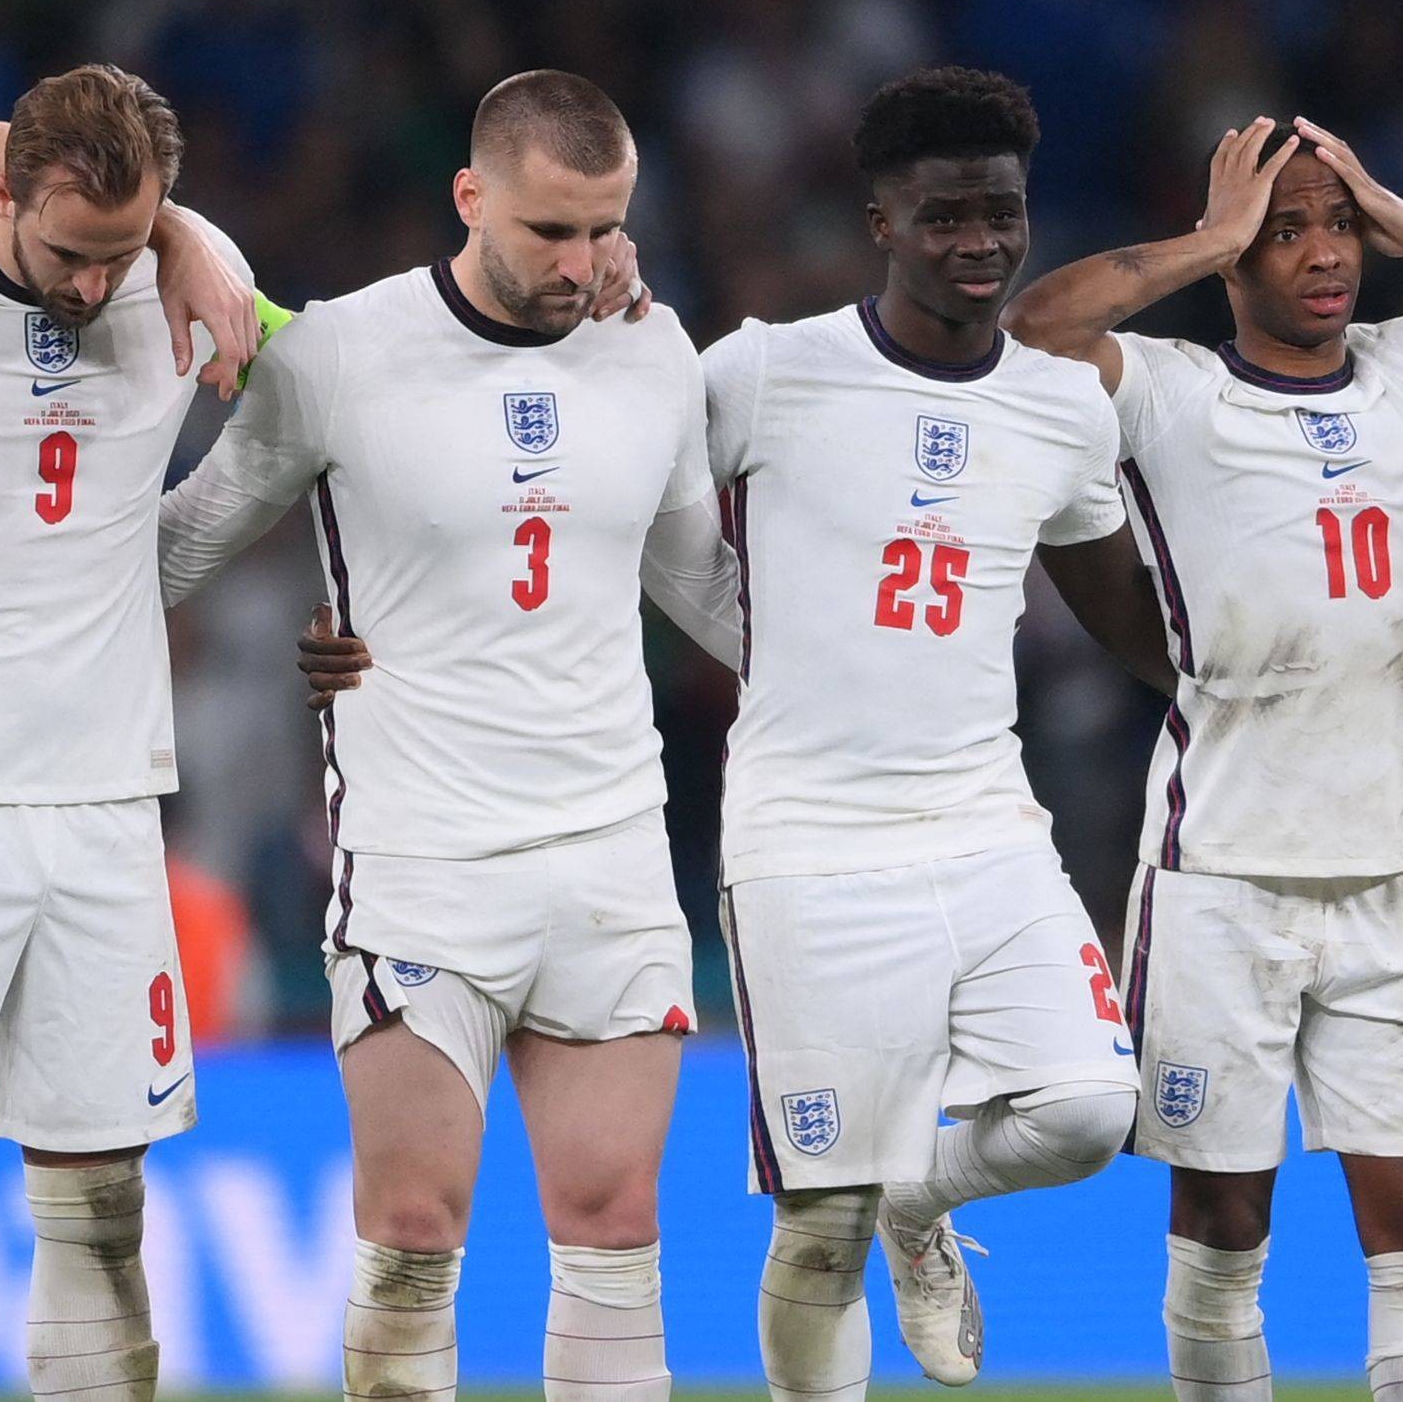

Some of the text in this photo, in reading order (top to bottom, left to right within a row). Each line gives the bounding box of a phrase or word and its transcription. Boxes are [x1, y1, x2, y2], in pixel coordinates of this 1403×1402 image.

[35, 432, 78, 524] 9
[512, 517, 551, 611] 3
[875, 538, 970, 638] 25
[1316, 506, 1392, 600] 10
[149, 972, 175, 1066] 9
